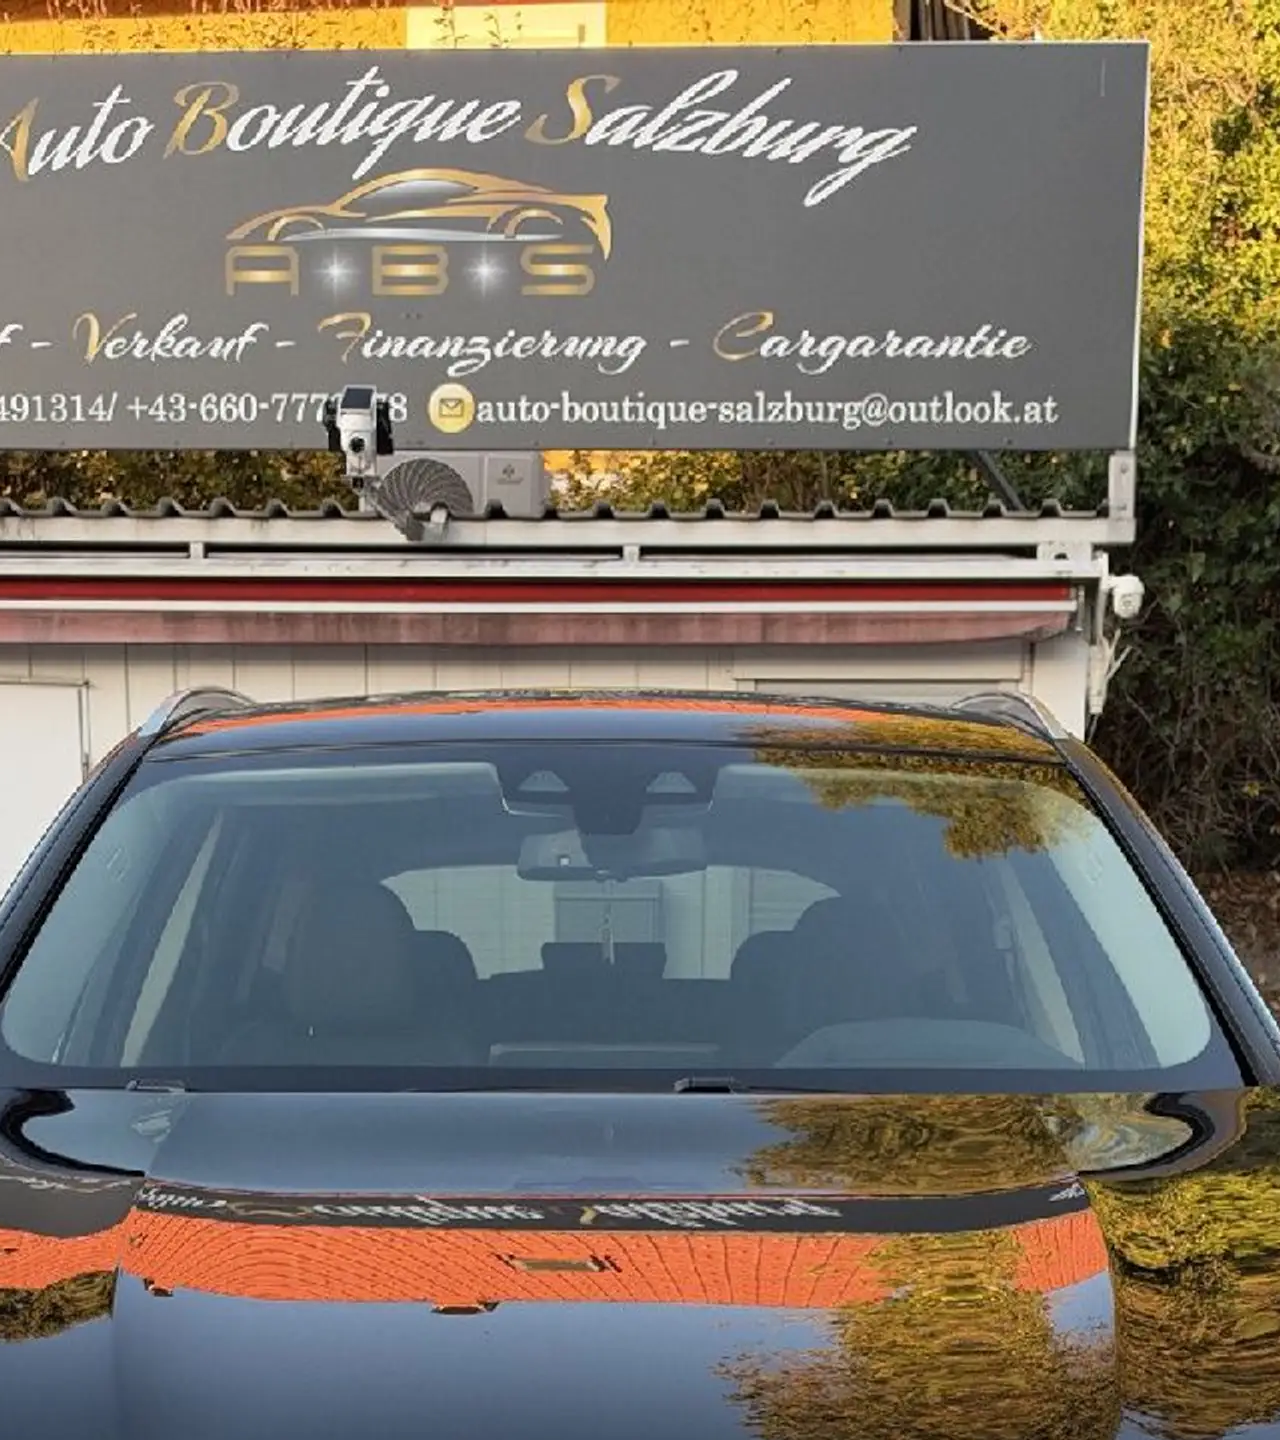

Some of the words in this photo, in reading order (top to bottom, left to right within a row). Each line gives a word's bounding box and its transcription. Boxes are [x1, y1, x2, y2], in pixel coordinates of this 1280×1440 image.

[163, 65, 522, 180] Boutique
[525, 69, 919, 208] Salzburg
[72, 311, 270, 366] Verkauf
[317, 311, 648, 378] Finanzierung
[712, 310, 1032, 375] Cargarantie
[476, 390, 1060, 430] auto-boutique-salzburg@outlook.at
